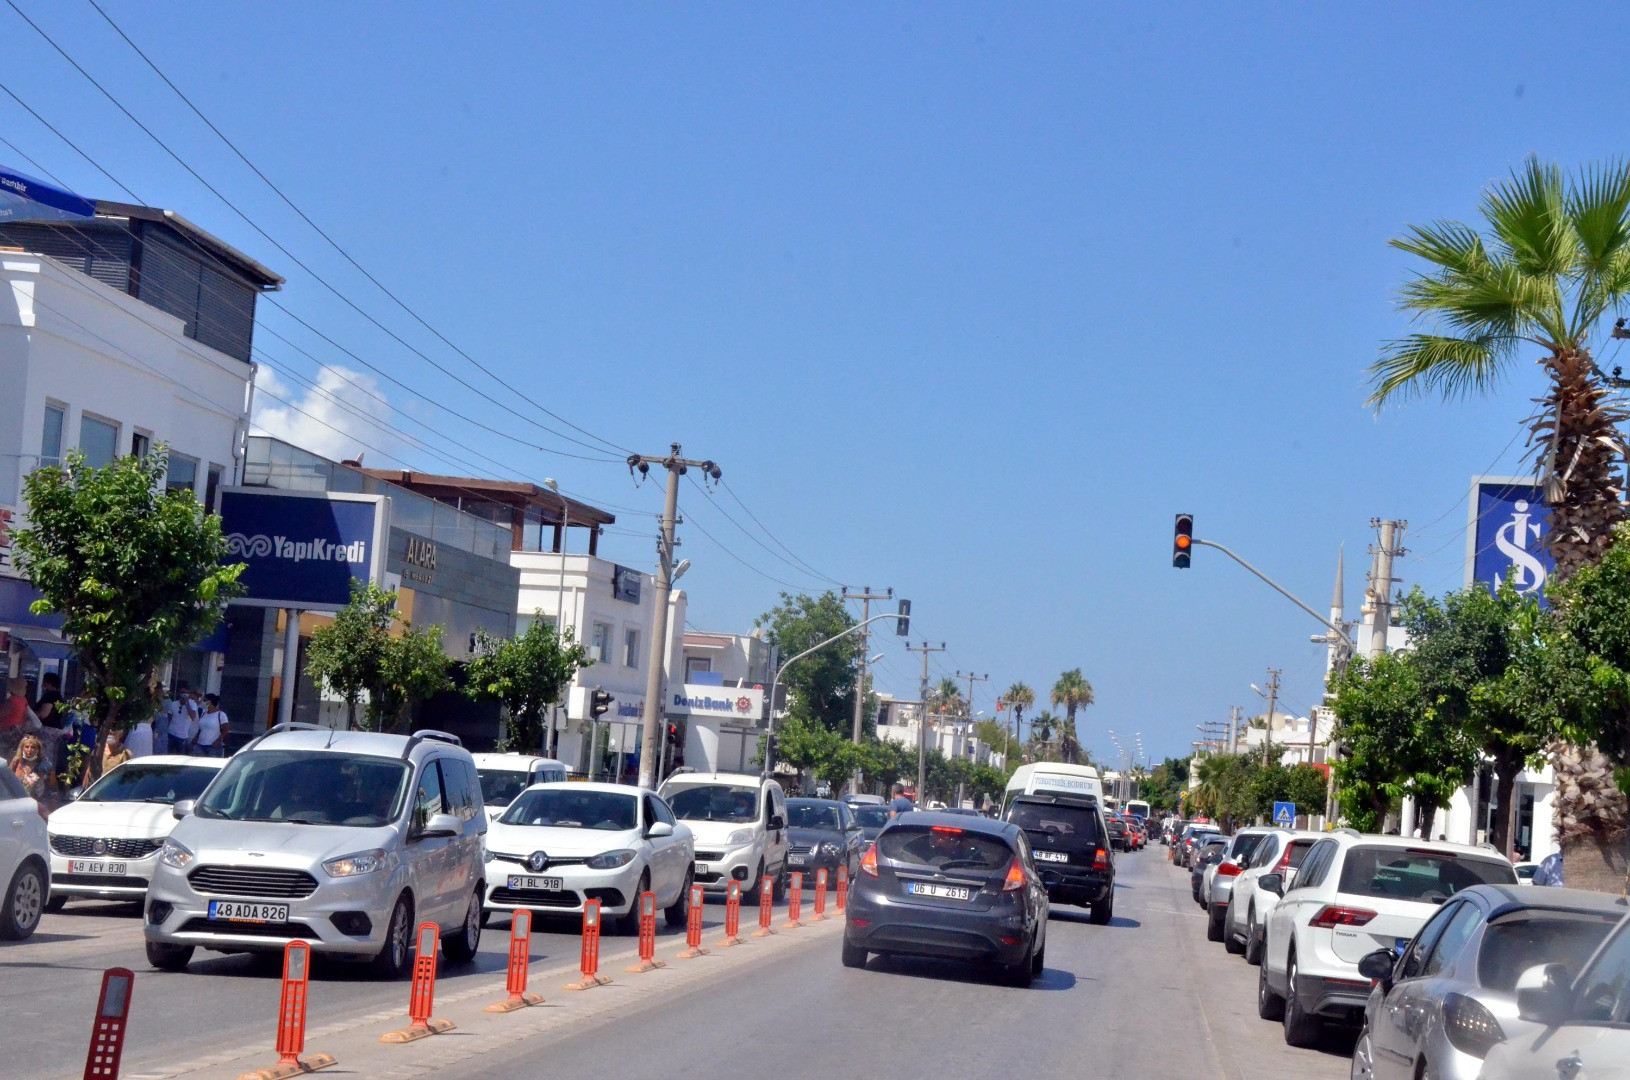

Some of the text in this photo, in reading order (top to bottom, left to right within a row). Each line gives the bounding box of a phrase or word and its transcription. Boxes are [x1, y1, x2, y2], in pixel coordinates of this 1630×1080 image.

[273, 535, 365, 563] YapıKredi
[407, 537, 436, 569] ALARA
[673, 694, 733, 712] DenizBank
[74, 862, 84, 872] 48
[109, 863, 125, 873] 830
[513, 877, 559, 889] 21 BL 918
[914, 883, 925, 894] 06
[930, 884, 937, 894] U
[945, 887, 968, 899] 2613
[217, 903, 233, 916] 48
[235, 905, 259, 918] ADA
[261, 906, 285, 920] 826
